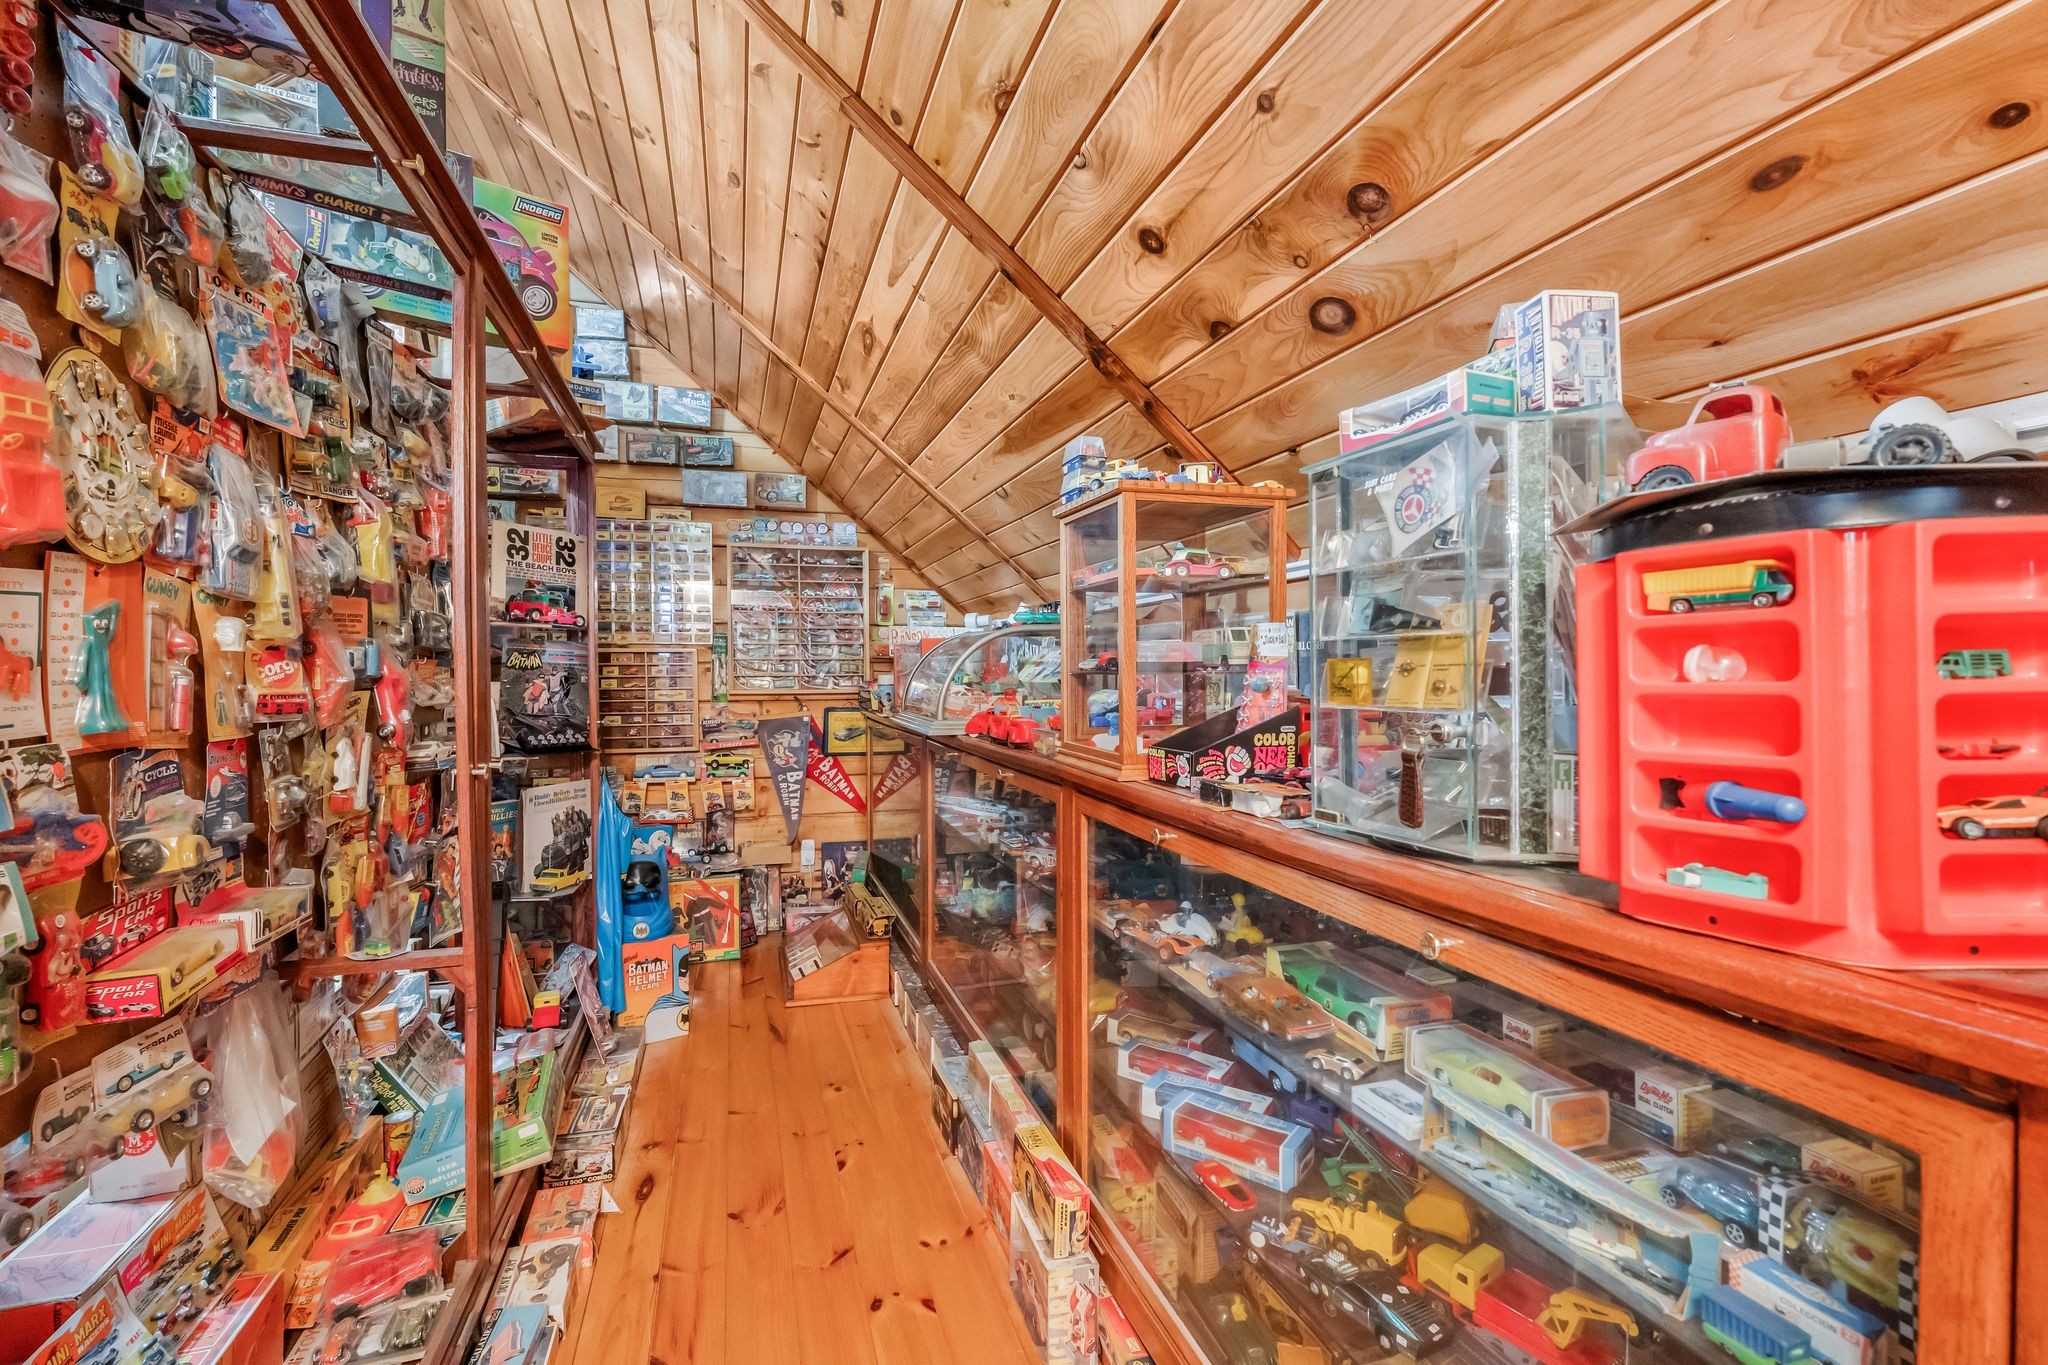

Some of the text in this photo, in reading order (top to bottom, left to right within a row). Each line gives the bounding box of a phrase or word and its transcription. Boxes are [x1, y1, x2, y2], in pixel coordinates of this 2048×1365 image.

[313, 193, 377, 217] CHARIOT
[515, 198, 563, 222] LINDBERG
[683, 397, 710, 407] Much!
[687, 391, 706, 400] Two
[321, 412, 347, 428] WORK
[154, 435, 164, 446] SET
[323, 485, 354, 497] DANGER
[532, 531, 552, 544] LITTLE
[532, 542, 553, 554] DEUCE
[532, 551, 553, 564] COUPE
[506, 560, 576, 575] THE BEACH BOYS
[146, 576, 180, 600] GUMBY
[507, 652, 542, 669] BATMAN
[1254, 733, 1296, 746] COLOR
[1253, 747, 1287, 768] NEE
[144, 764, 178, 782] CYCLE
[818, 756, 855, 800] BATMAN
[820, 775, 840, 794] ROBIN
[779, 782, 790, 806] ROBIN
[786, 771, 804, 820] BATMAN
[96, 889, 163, 935] Sports
[124, 906, 156, 928] CAR
[628, 960, 668, 977] BATMAN
[628, 970, 668, 987] HELMET
[642, 982, 661, 991] CAPE
[86, 979, 154, 1000] Sports
[112, 988, 146, 1000] CAR
[139, 1028, 184, 1056] FERRARI
[64, 1082, 92, 1102] COOPER
[437, 1161, 458, 1173] FARM
[446, 1179, 458, 1188] SET
[587, 1173, 613, 1182] COMBO
